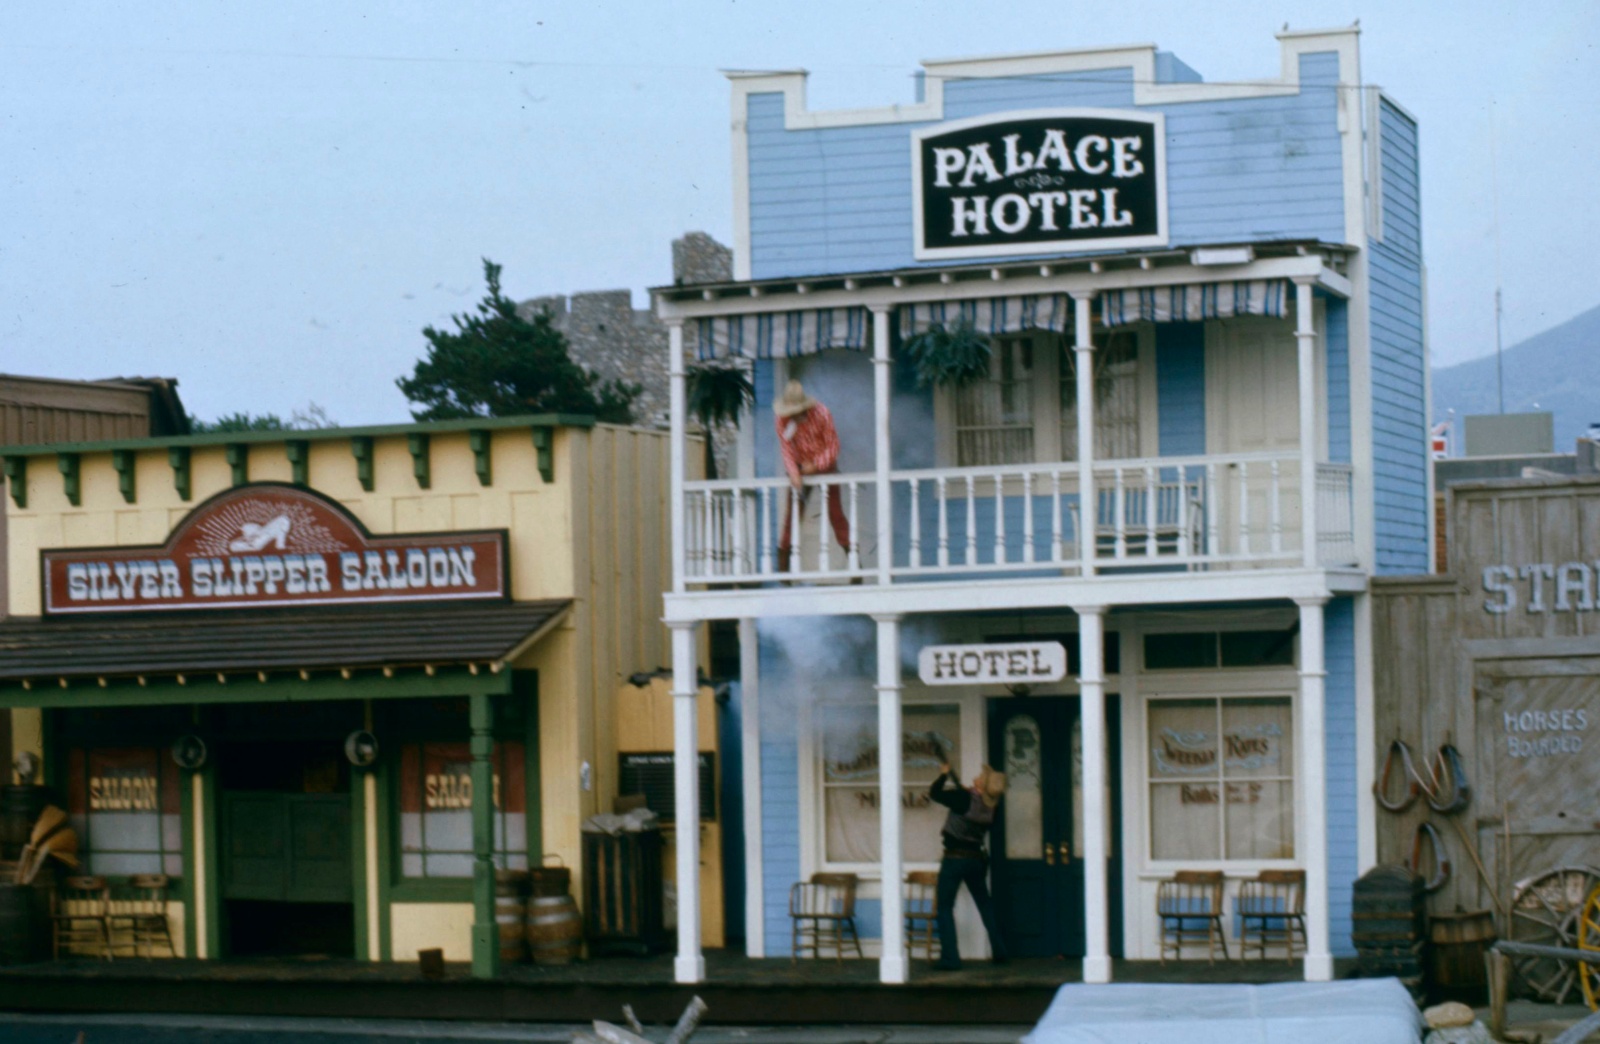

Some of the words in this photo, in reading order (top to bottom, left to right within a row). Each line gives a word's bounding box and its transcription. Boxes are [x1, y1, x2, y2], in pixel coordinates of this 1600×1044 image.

[933, 129, 1144, 187] PALACE
[950, 188, 1133, 236] HOTEL
[66, 557, 182, 600] SILVER
[191, 552, 330, 597] SLIPPER
[340, 545, 476, 592] SALOON
[1482, 561, 1600, 614] STA
[934, 649, 1052, 678] HOTEL
[1503, 709, 1588, 732] HORSES
[90, 777, 157, 810] SALOON
